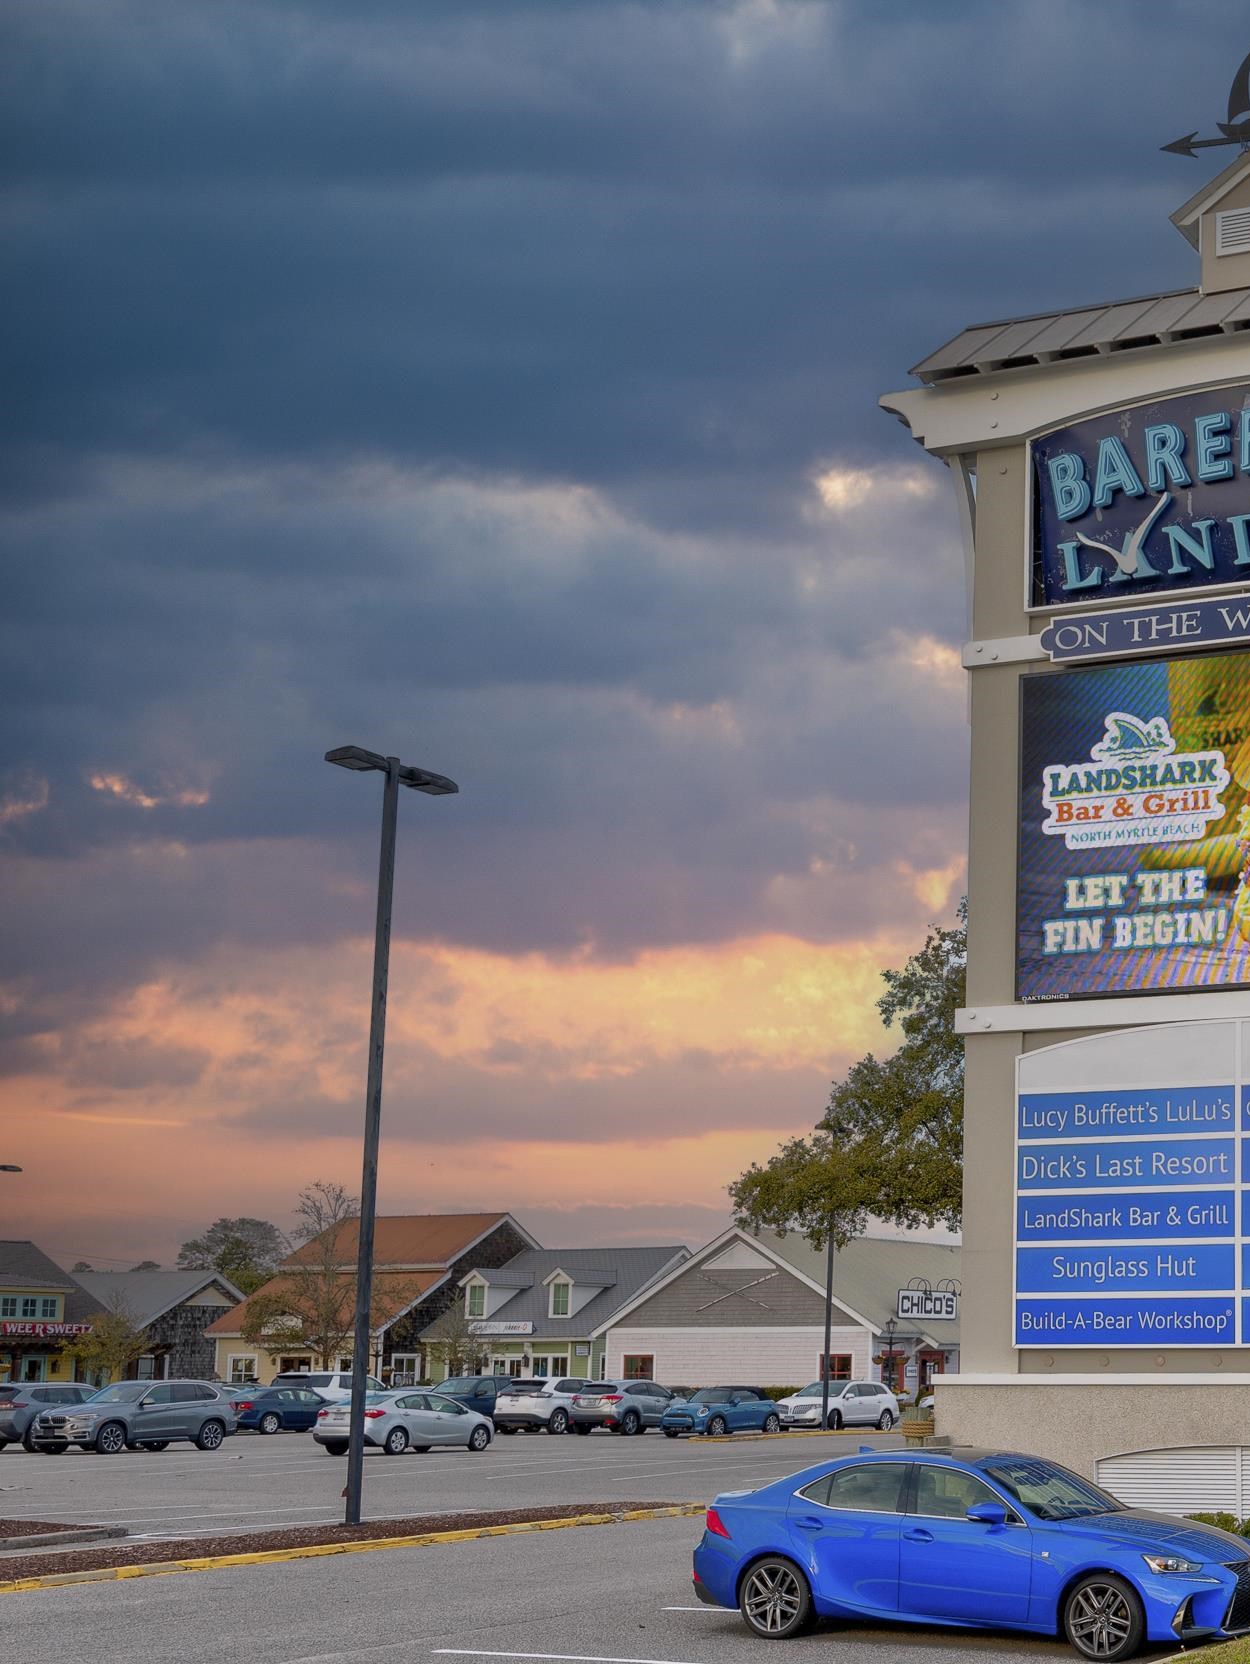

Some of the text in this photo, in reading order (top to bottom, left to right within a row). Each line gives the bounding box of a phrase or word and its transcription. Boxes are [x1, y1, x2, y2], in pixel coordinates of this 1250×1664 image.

[1054, 621, 1107, 652] ON
[1123, 611, 1202, 643] THE
[1050, 758, 1218, 797] LANDSHARK
[1055, 789, 1212, 823] Bar & Grill
[1070, 822, 1200, 843] NORTH MYRTLE BEACH
[1065, 868, 1206, 909] LET THE
[1043, 908, 1227, 953] FIN BEGIN!
[1021, 992, 1070, 1001] DAKTRONICS
[1022, 1098, 1231, 1132] Lucy Buffett's LuLu's
[1022, 1151, 1229, 1179] Dick's Last Resort
[1024, 1204, 1229, 1228] LandShark Bar & Grill
[1052, 1255, 1196, 1283] Sunglass Hut
[900, 1294, 954, 1315] CHICO'S
[7, 1323, 33, 1334] WEE
[35, 1323, 45, 1337] R
[1021, 1311, 1133, 1330] Build-A-Bear
